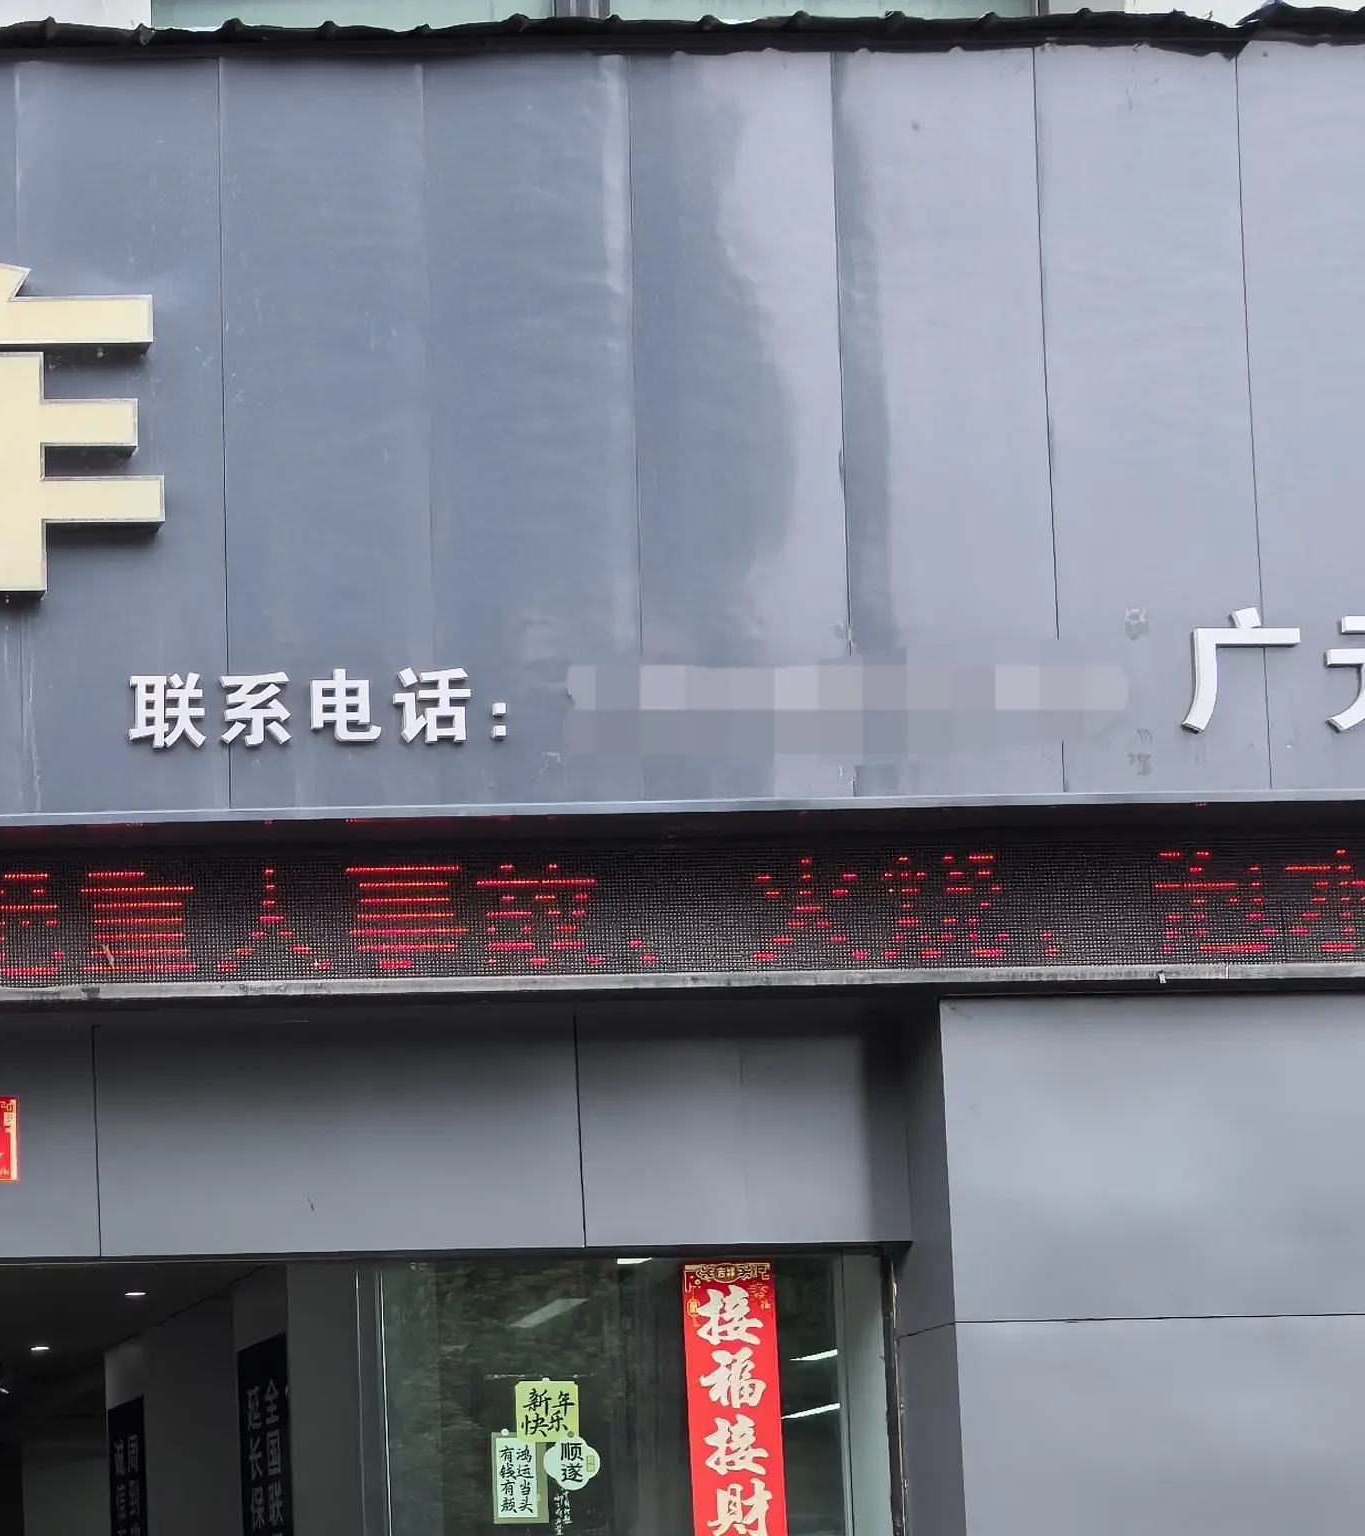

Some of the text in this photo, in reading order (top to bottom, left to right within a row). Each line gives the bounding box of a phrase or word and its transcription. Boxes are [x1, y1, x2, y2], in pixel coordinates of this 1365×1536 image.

[516, 1444, 534, 1514] 鸿运当头
[560, 1441, 584, 1483] 顺遂
